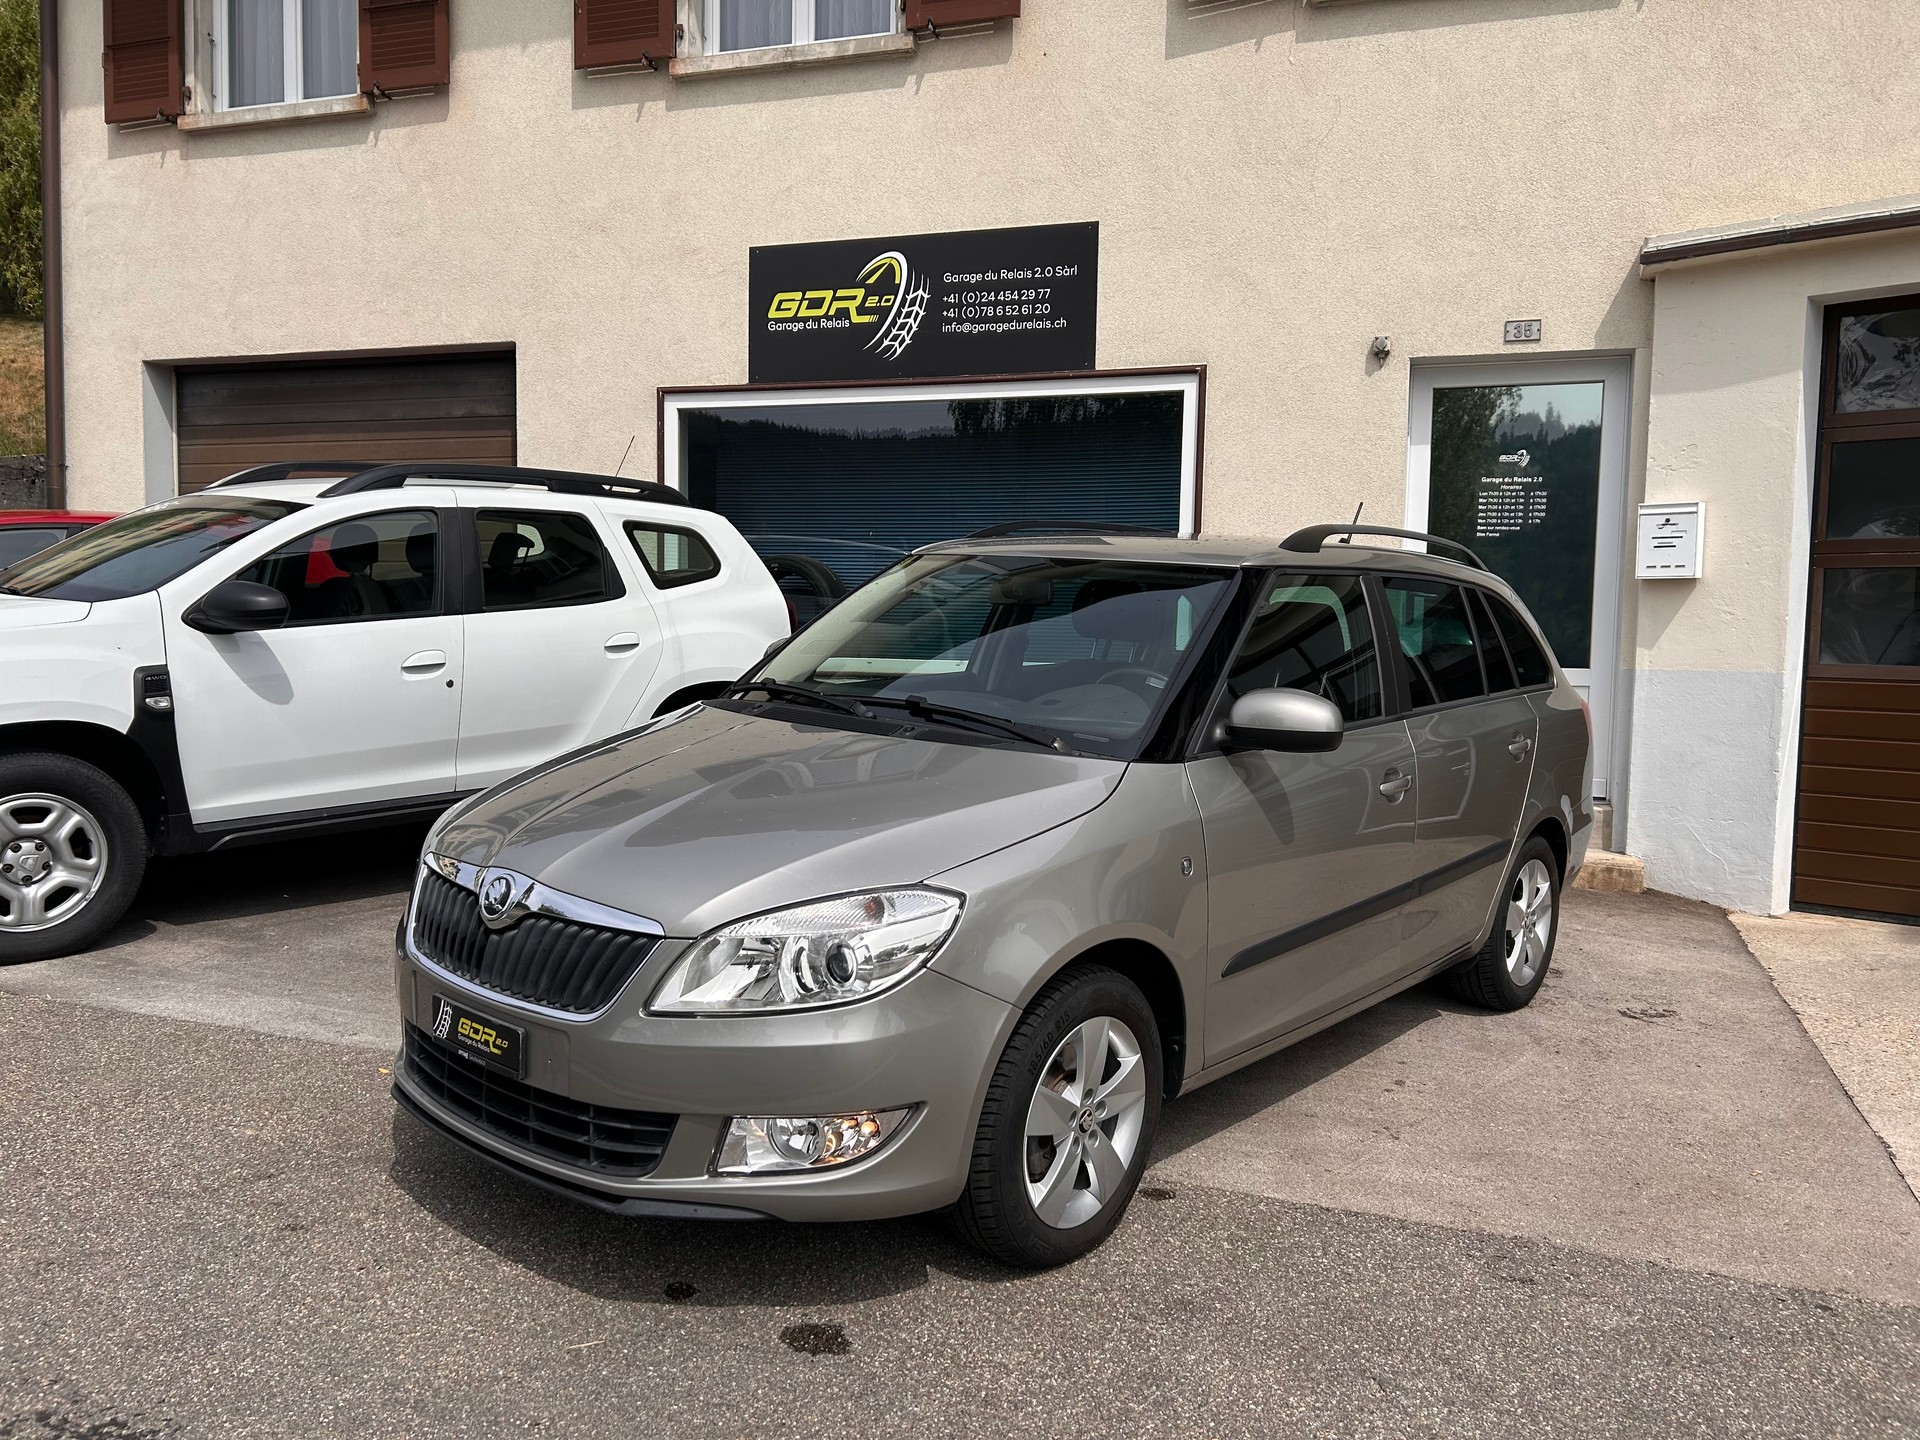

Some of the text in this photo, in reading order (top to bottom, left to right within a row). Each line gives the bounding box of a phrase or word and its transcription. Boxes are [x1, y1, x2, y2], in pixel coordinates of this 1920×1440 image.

[943, 264, 1078, 283] Garage du Relais 2.0 Sàrl
[942, 293, 959, 304] +41
[997, 290, 1019, 301] 454
[1020, 289, 1036, 300] 29
[1037, 288, 1051, 299] 77
[767, 288, 895, 323] GDR 2.0
[942, 308, 959, 318] +41
[1021, 304, 1033, 315] 61
[1034, 303, 1051, 314] 20
[767, 317, 850, 332] Garage du Relais
[942, 317, 1067, 334] info@garagedurelais.ch
[1513, 323, 1534, 339] 35
[458, 1017, 502, 1055] GDR
[1028, 1010, 1071, 1075] 185/60 R15
